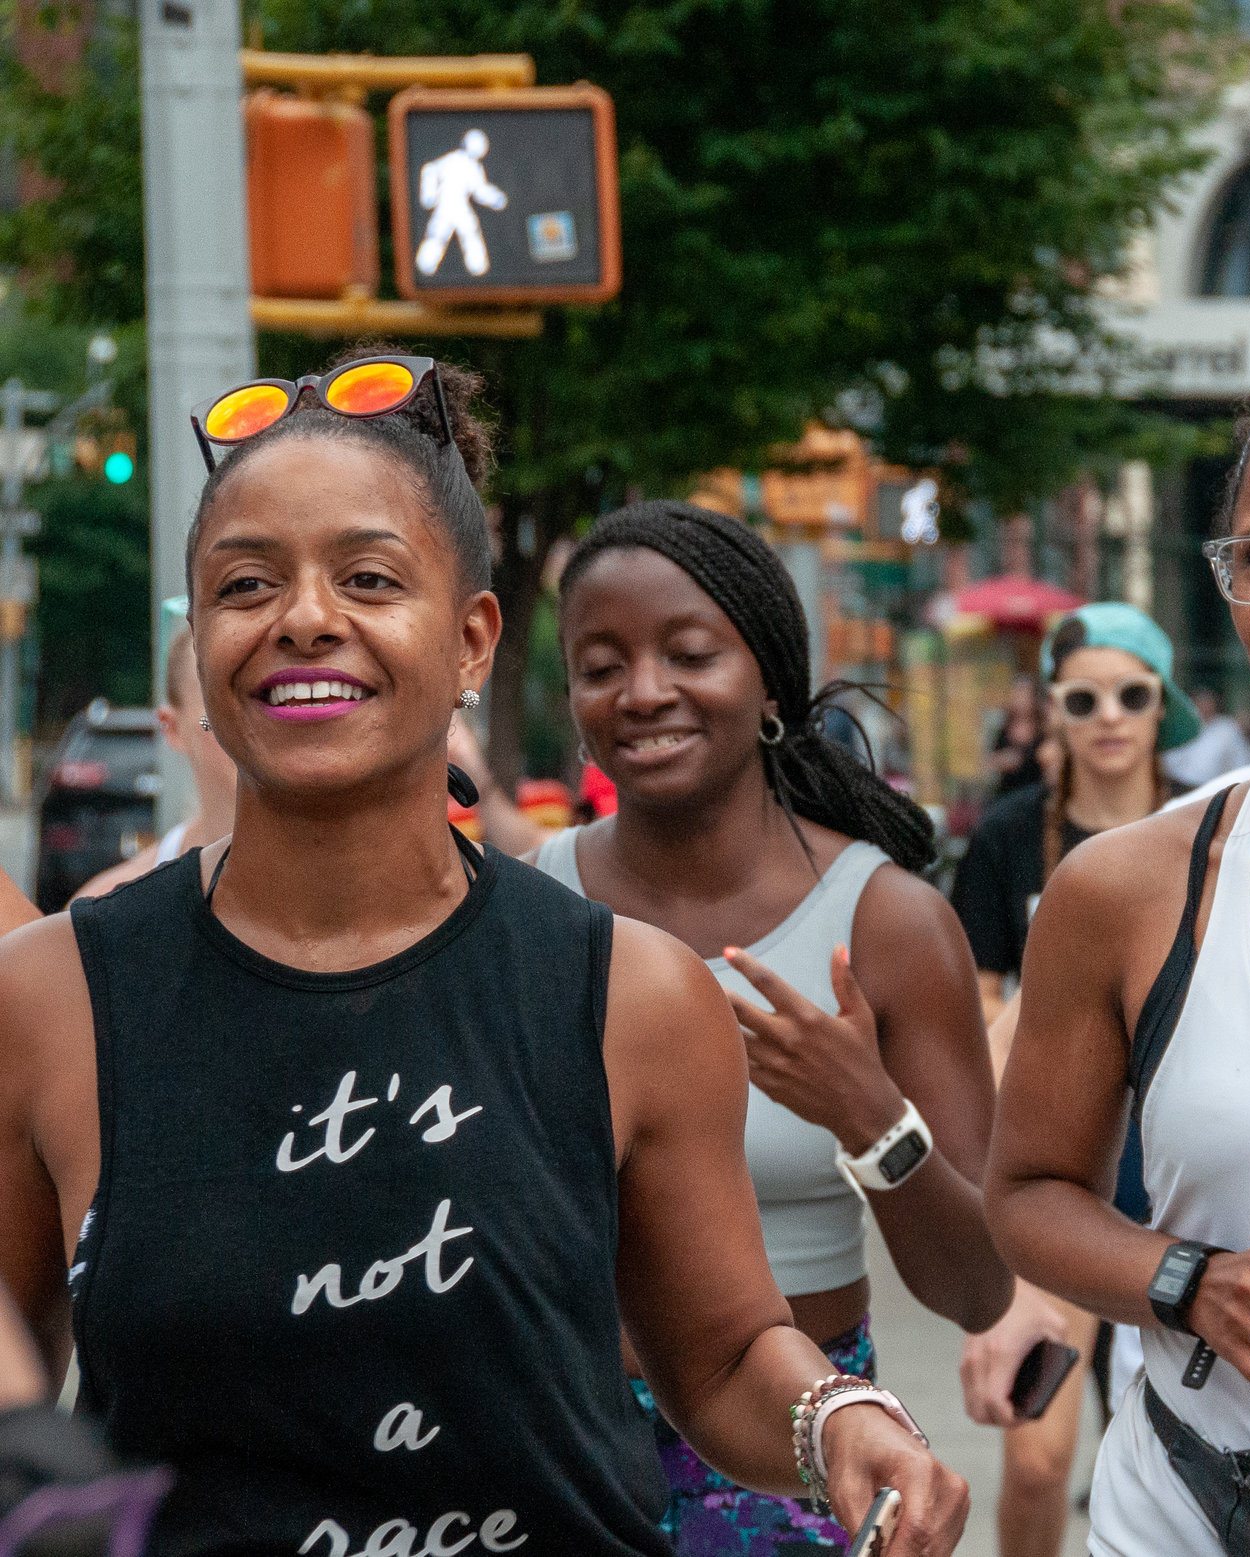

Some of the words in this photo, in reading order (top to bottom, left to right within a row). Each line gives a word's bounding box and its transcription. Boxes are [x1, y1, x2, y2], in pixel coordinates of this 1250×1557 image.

[276, 1070, 483, 1172] it's
[291, 1198, 474, 1315] not
[373, 1401, 440, 1451] a
[297, 1508, 529, 1557] race
